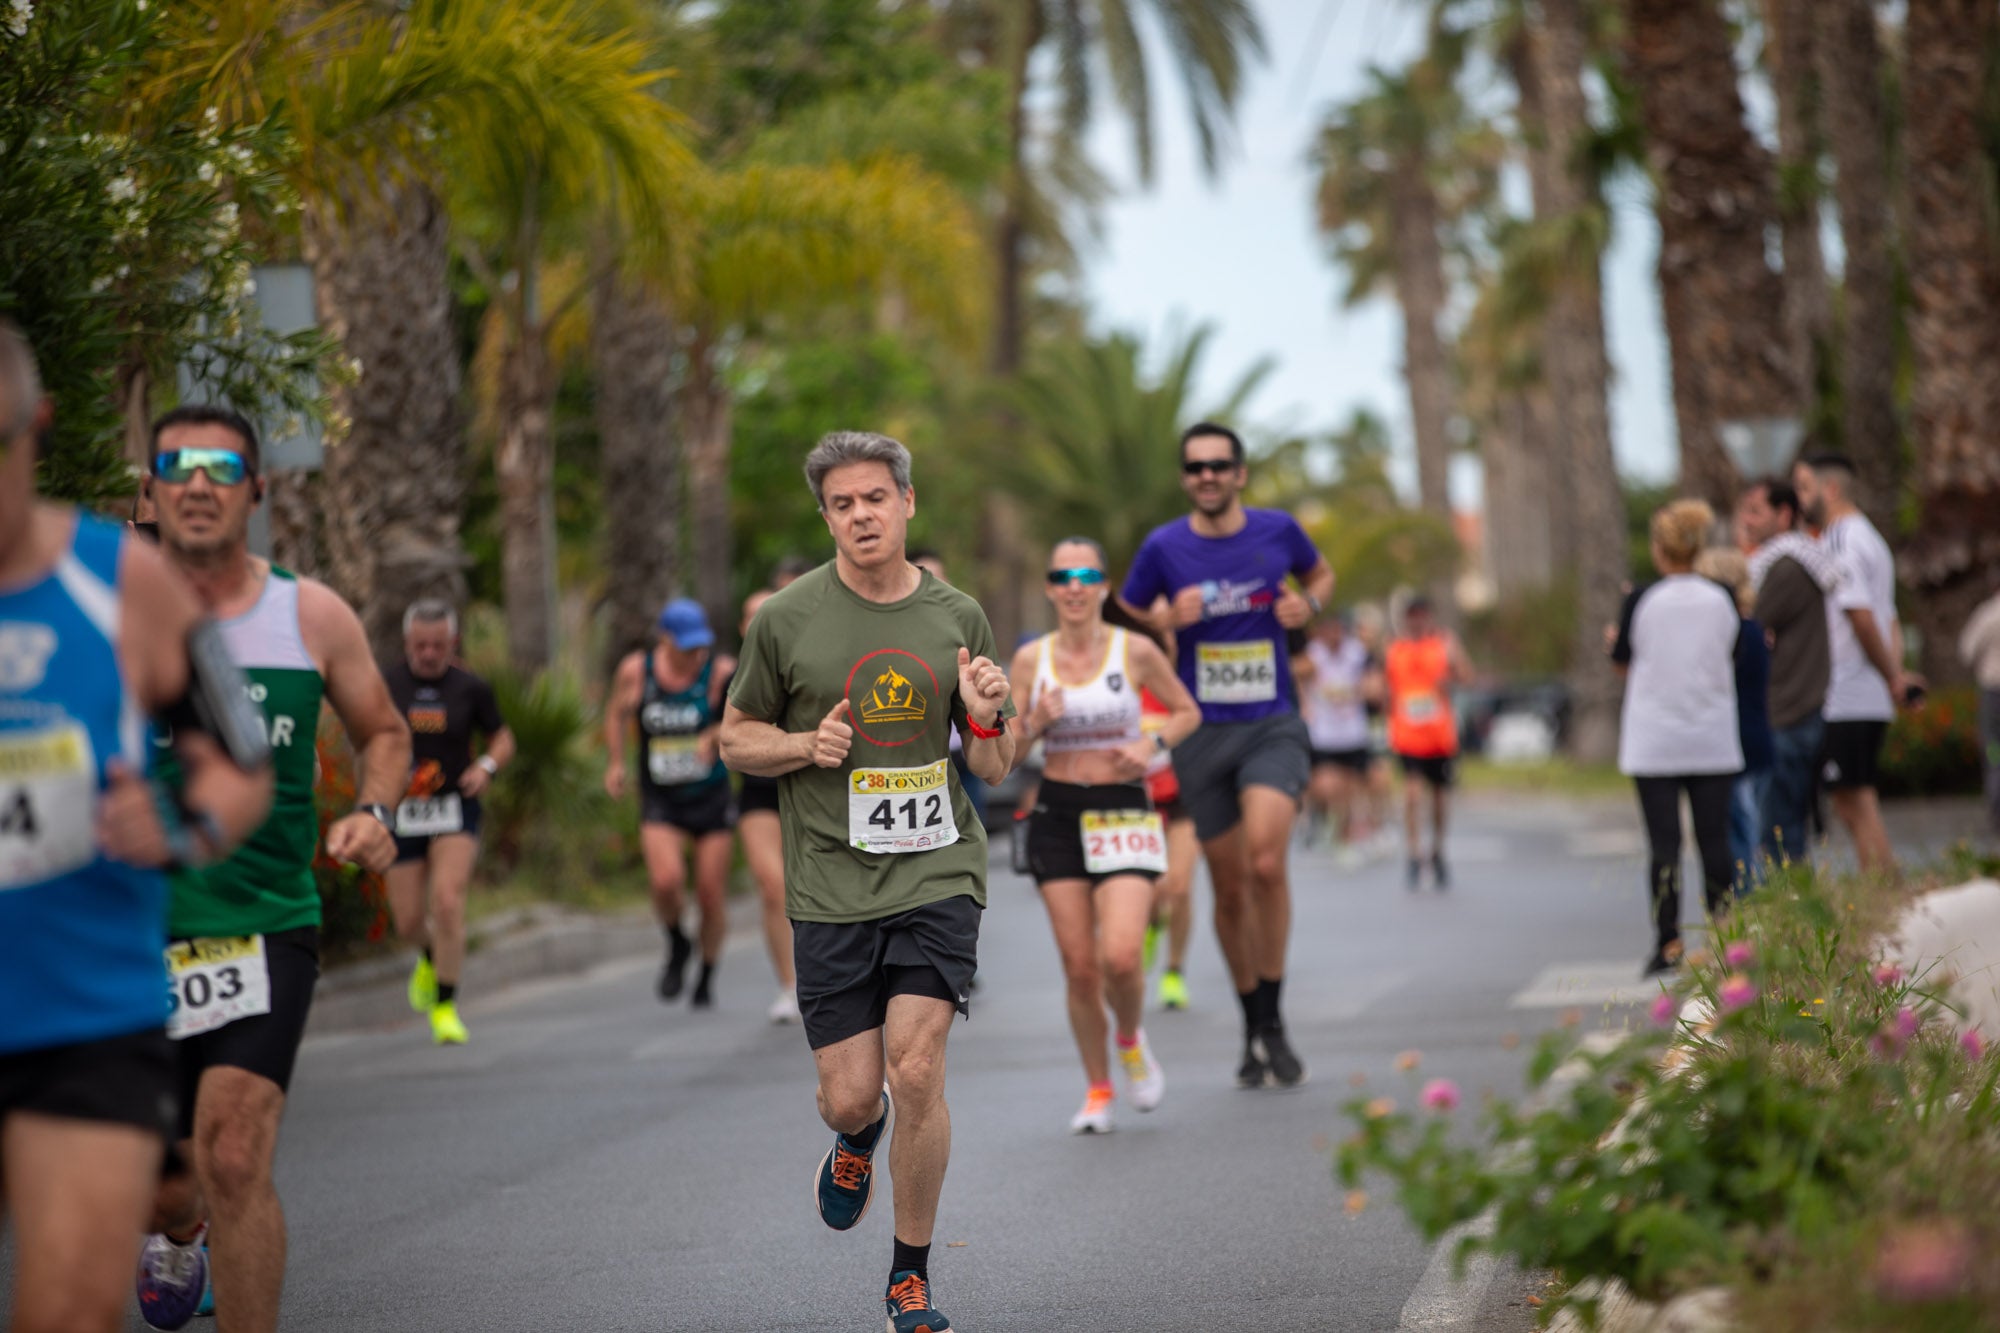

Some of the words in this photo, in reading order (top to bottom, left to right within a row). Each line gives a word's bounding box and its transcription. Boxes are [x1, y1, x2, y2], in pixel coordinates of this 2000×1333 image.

[867, 773, 885, 788] 38
[885, 773, 936, 789] FONDO
[868, 794, 943, 831] 412
[1088, 832, 1161, 857] 2108
